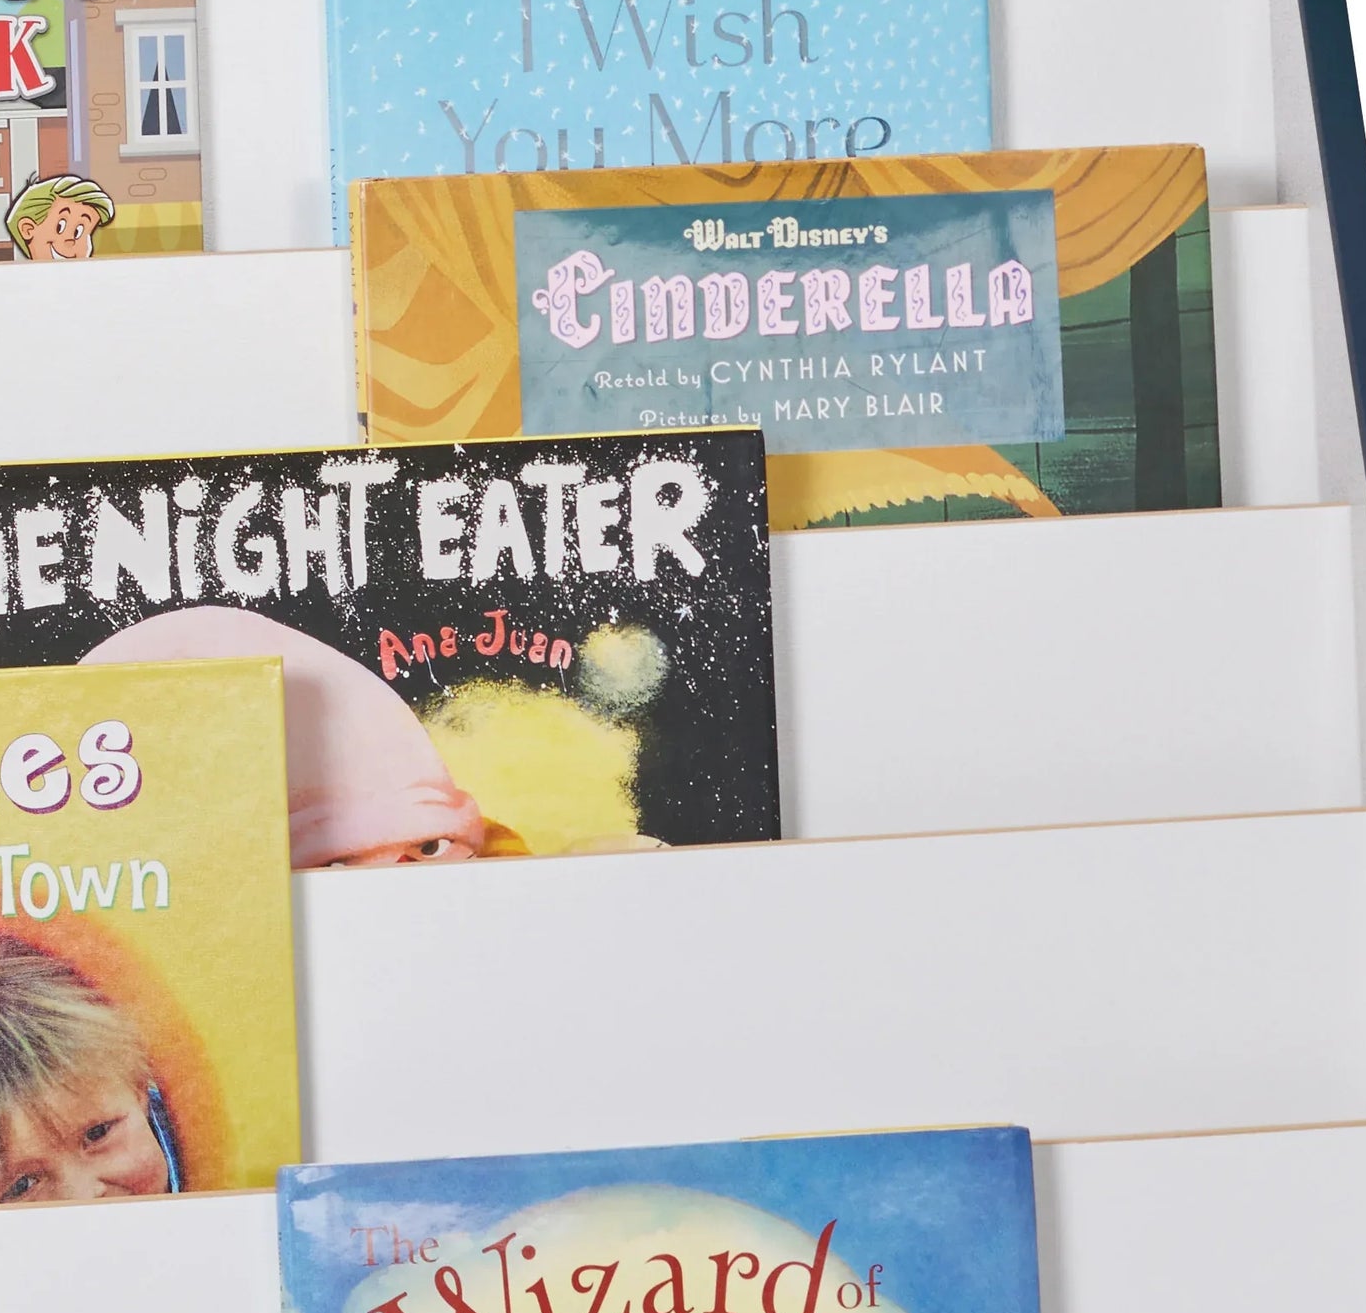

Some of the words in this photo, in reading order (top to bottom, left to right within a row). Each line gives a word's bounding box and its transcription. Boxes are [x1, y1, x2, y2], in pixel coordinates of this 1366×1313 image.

[438, 97, 604, 174] You
[649, 91, 892, 167] More
[531, 248, 1034, 350] CINDERELLA
[594, 368, 669, 389] Retold
[677, 367, 702, 388] by
[710, 354, 853, 384] CYNTHIA
[871, 350, 987, 377] RYLANT
[639, 408, 729, 428] Pictures
[738, 405, 762, 427] by
[775, 395, 852, 423] MARY
[866, 391, 944, 418] BLAIR
[416, 459, 712, 589] EATER
[378, 626, 458, 681] Ana
[474, 609, 573, 669] Juan
[350, 1225, 441, 1268] The
[835, 1264, 885, 1310] of
